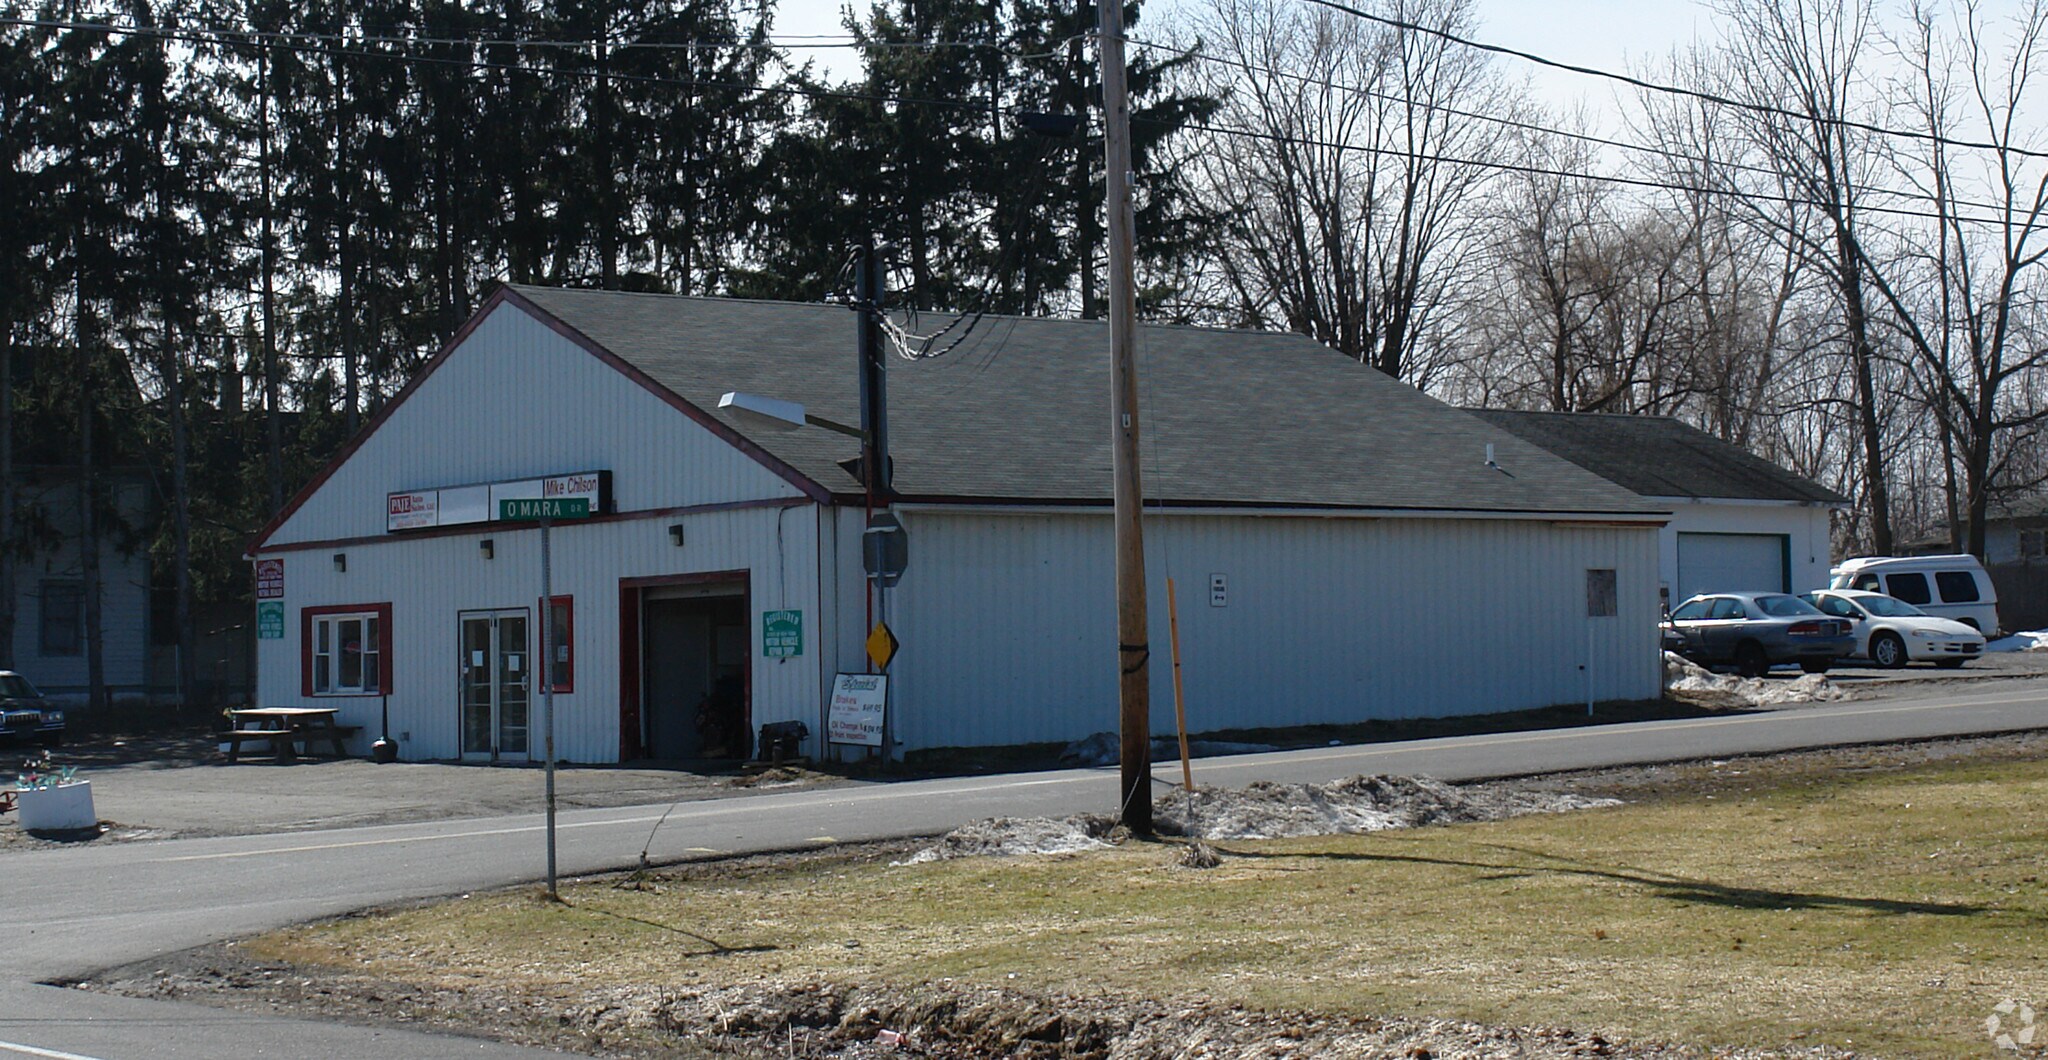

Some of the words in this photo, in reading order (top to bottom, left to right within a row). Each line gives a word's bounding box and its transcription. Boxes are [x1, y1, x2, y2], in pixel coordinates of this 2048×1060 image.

[546, 480, 564, 496] Mike
[567, 477, 597, 494] Chilson
[508, 501, 516, 517] O
[521, 501, 561, 516] MARA
[571, 504, 581, 513] DR
